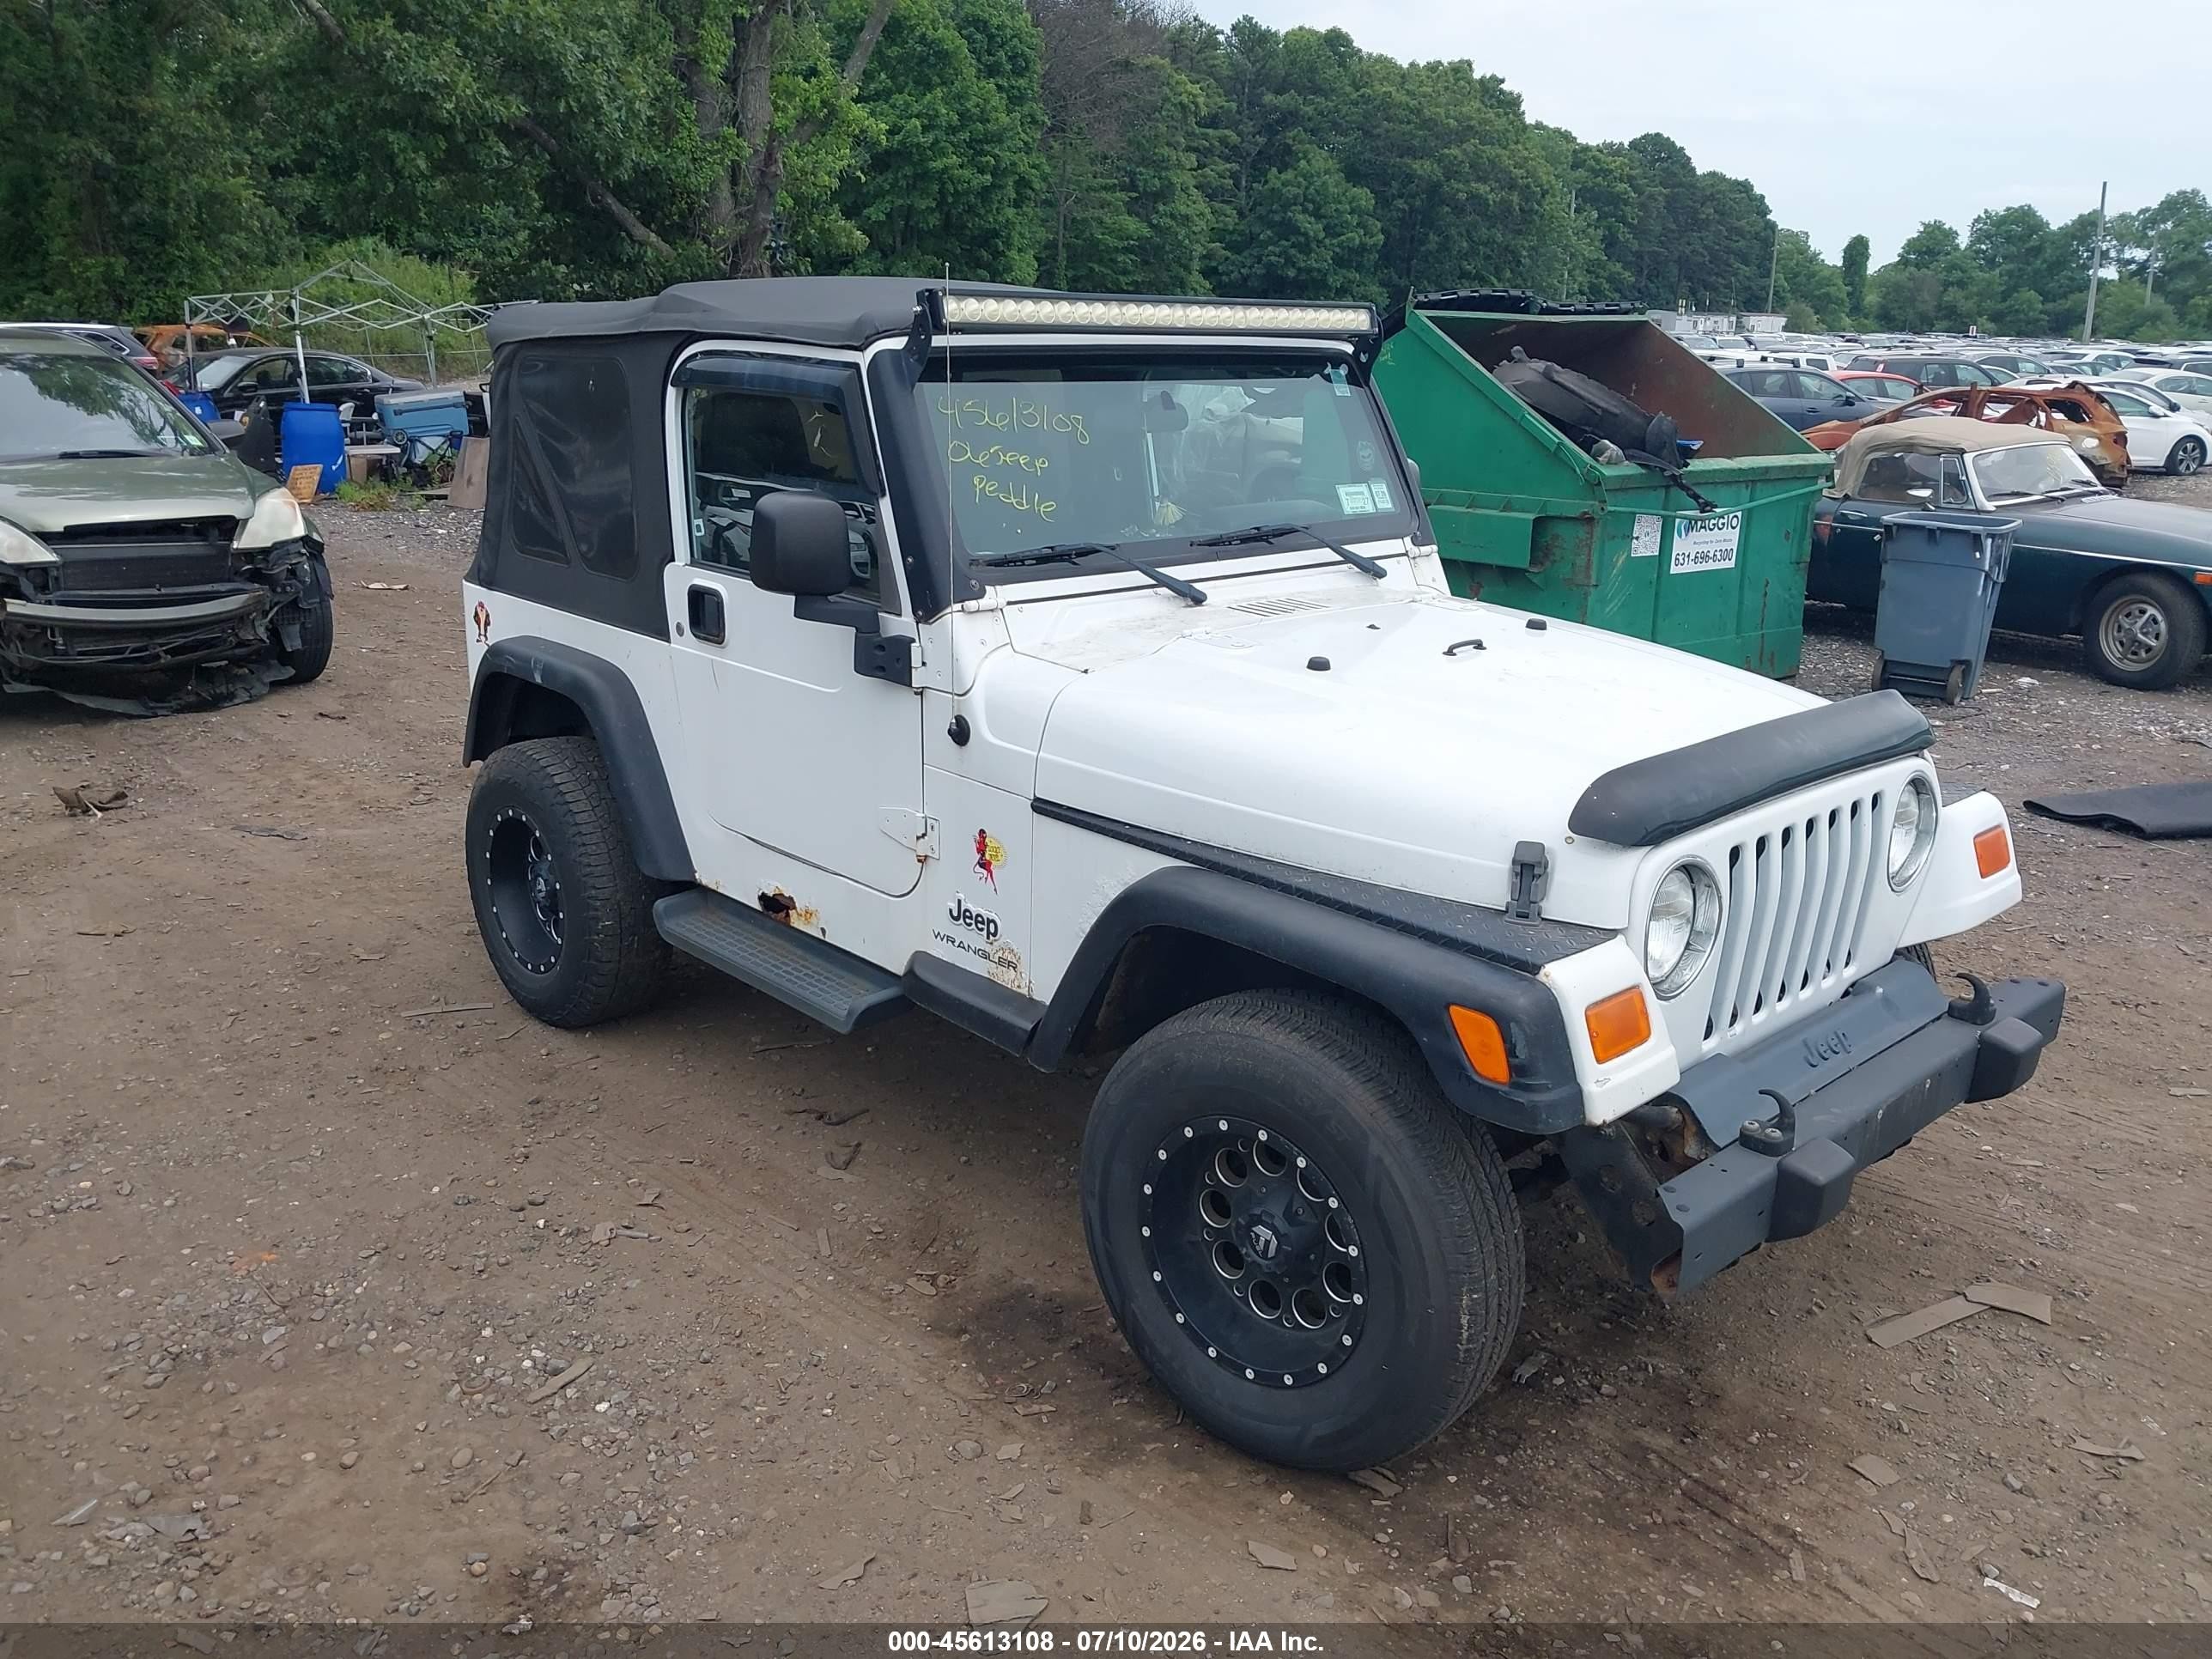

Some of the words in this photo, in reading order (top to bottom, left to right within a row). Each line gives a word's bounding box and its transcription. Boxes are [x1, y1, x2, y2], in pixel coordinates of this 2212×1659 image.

[938, 396, 1090, 445] 45613108
[1689, 514, 1740, 533] MAGGIO
[1674, 548, 1734, 567] 631-696-6300
[948, 897, 1000, 940] Jeep
[932, 928, 1018, 974] WRANGLER
[1802, 1030, 1853, 1068] Jeep
